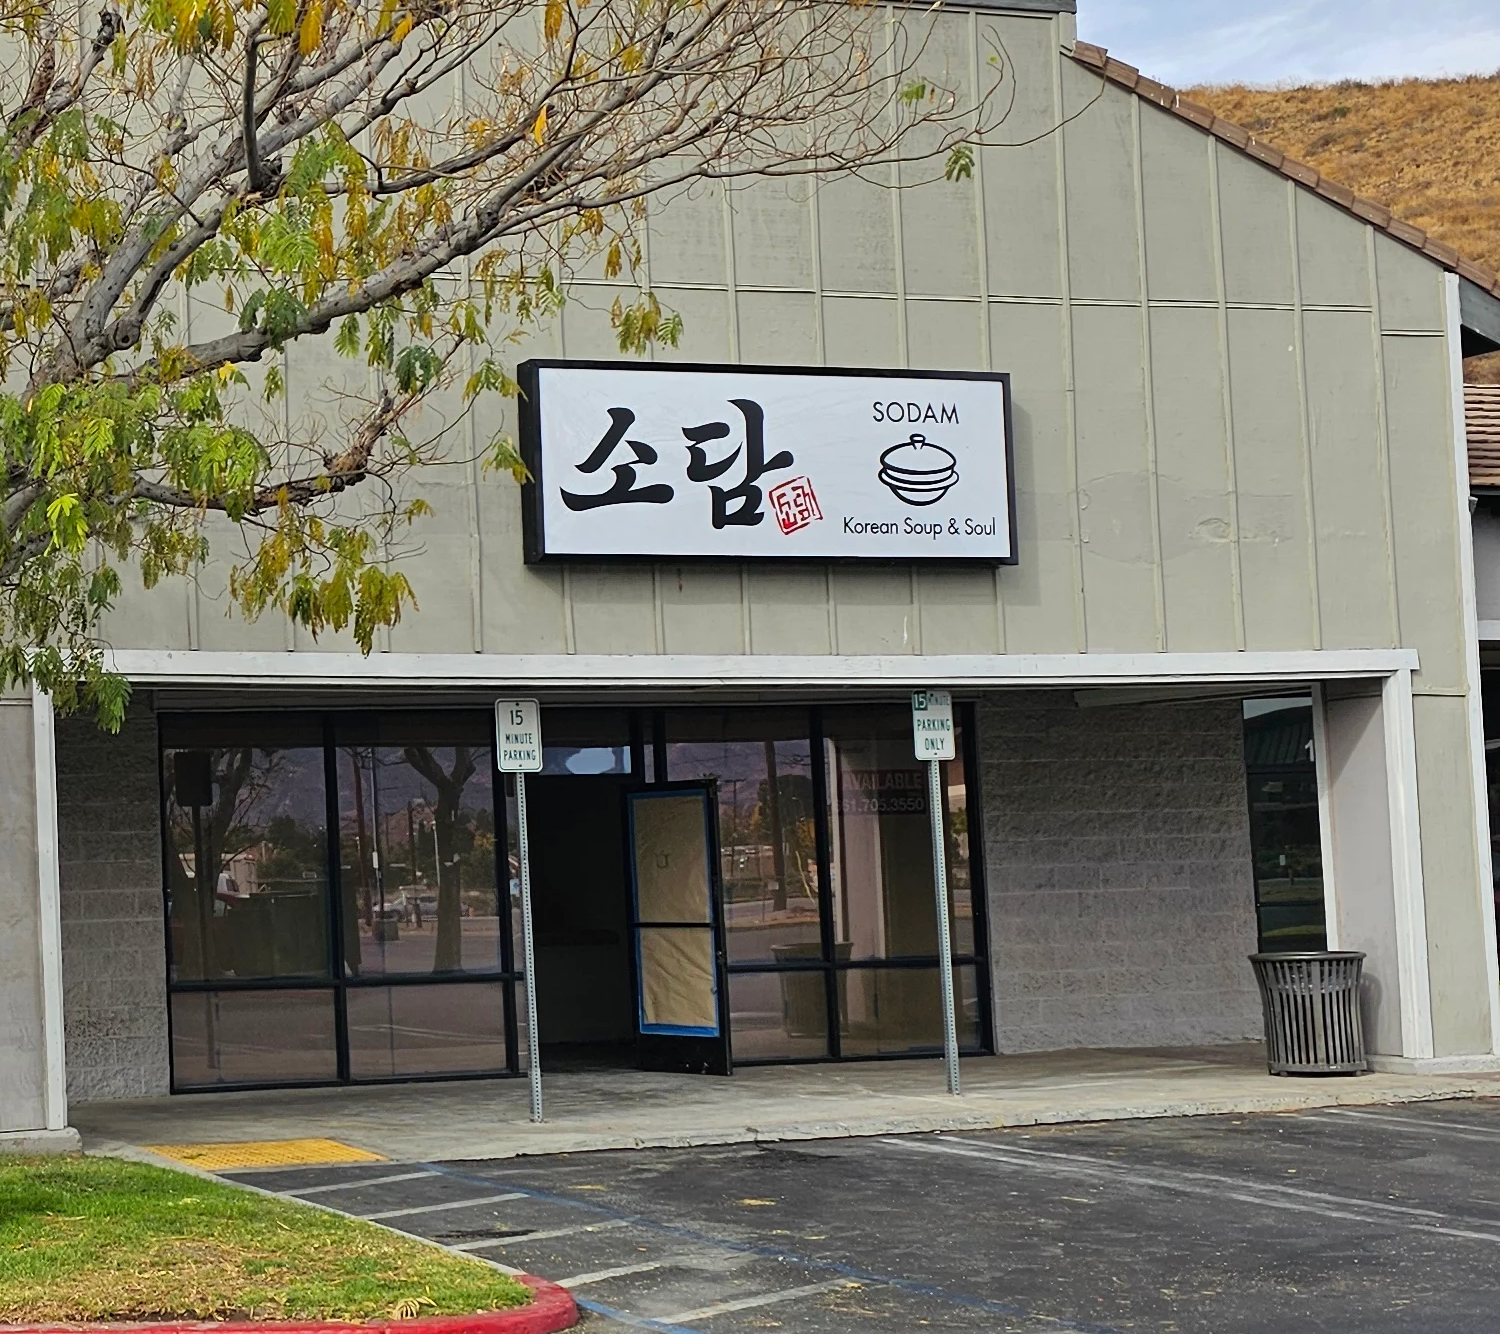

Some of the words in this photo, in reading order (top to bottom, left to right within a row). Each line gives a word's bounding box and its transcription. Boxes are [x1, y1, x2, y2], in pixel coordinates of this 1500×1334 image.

[872, 401, 960, 424] SODAM
[559, 398, 795, 530] 소담
[843, 515, 899, 535] Korean
[903, 516, 943, 540] Soup
[947, 517, 960, 535] &
[964, 516, 996, 536] Soul
[913, 693, 927, 708] 15
[510, 709, 523, 725] 15
[916, 718, 951, 732] PARKING
[505, 732, 533, 744] MINUTE
[924, 737, 945, 751] ONLY
[503, 749, 536, 761] PARKING
[842, 771, 923, 789] AVAILABLE
